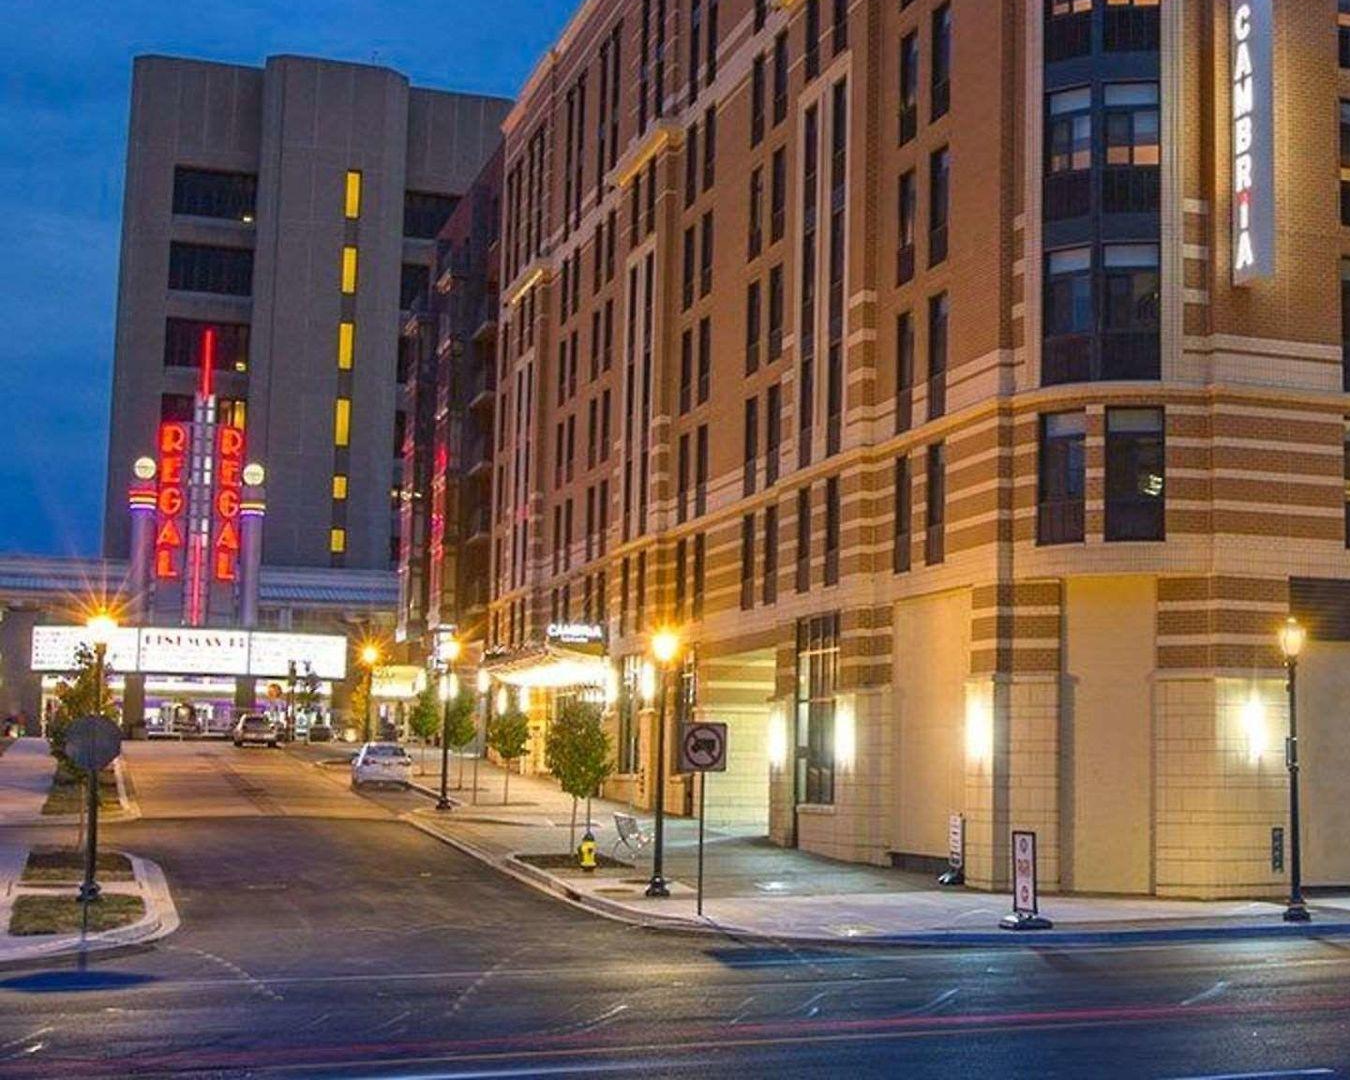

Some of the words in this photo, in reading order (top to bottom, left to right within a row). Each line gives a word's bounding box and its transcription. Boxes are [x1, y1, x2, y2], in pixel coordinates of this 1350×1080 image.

[1234, 3, 1254, 270] CAMBRIA
[157, 423, 185, 577] REGAL
[216, 427, 243, 580] REGAL
